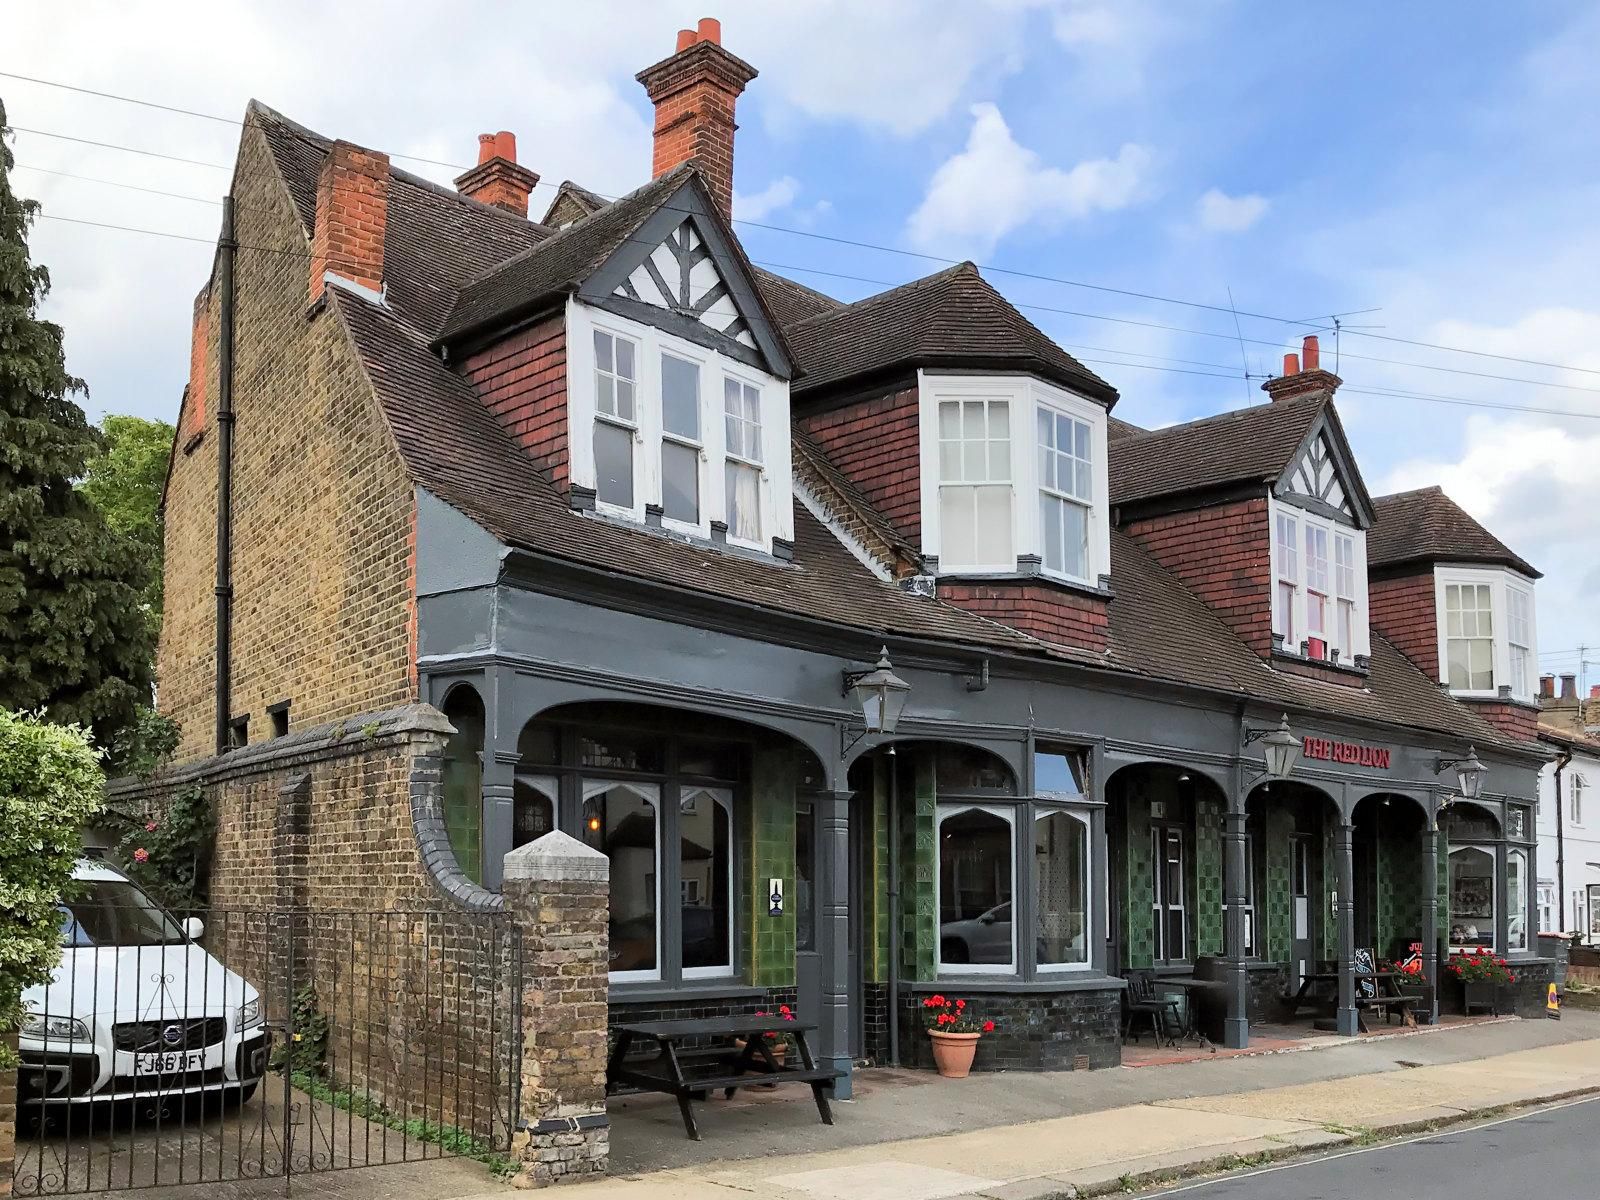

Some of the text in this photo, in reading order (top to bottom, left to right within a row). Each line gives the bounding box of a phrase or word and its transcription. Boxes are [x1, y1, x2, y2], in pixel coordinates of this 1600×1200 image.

[1303, 736, 1392, 769] THE RED LION
